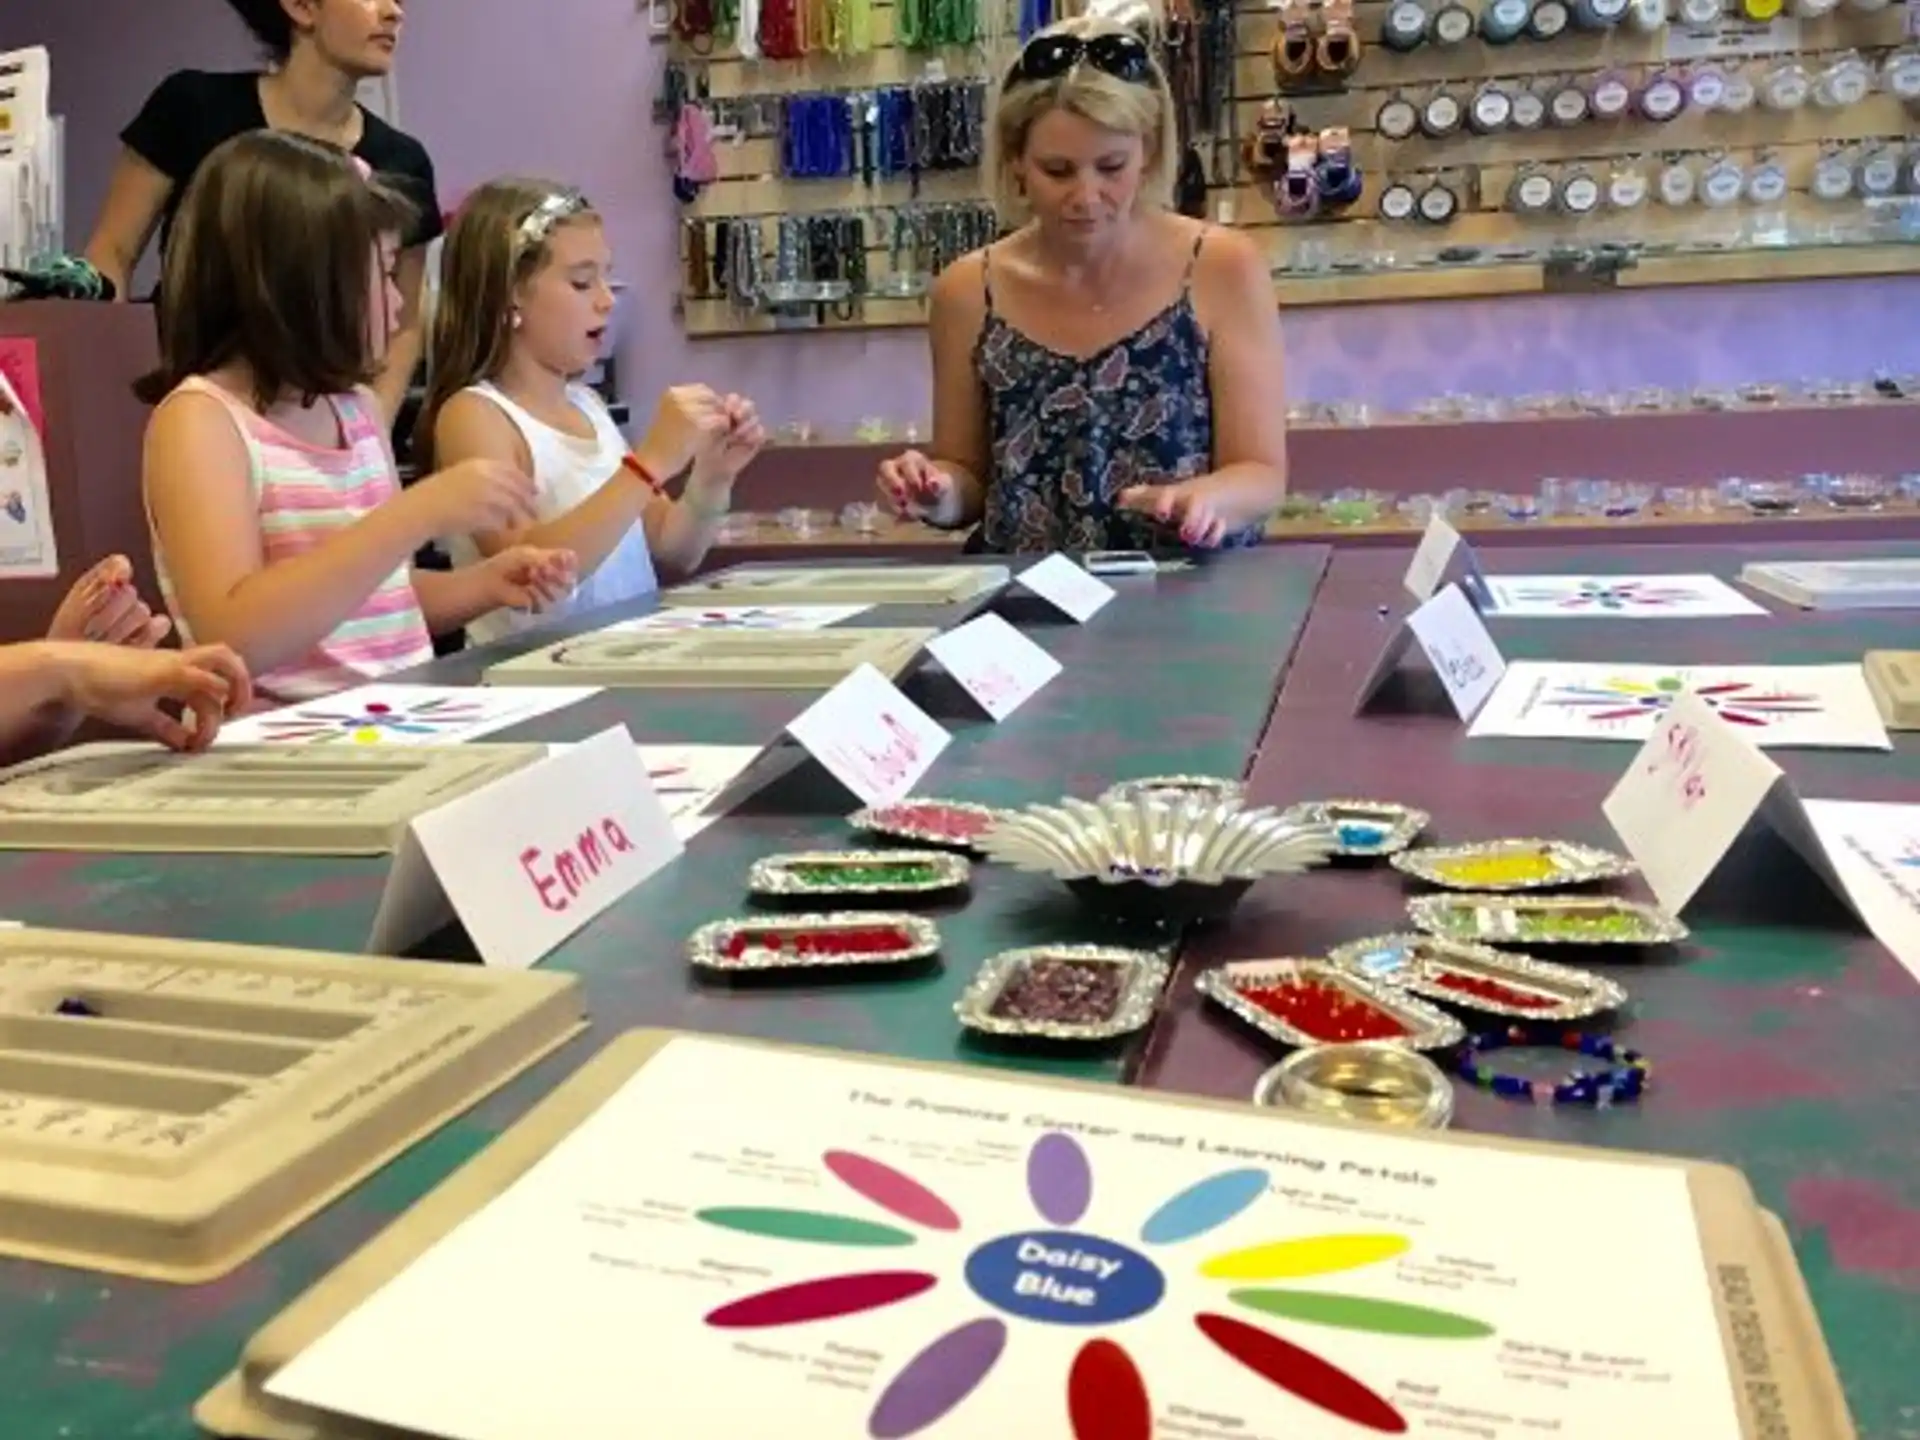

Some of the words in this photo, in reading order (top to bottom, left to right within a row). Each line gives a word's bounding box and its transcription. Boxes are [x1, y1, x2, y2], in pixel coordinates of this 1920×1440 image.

[519, 817, 637, 912] Emma
[1131, 1132, 1186, 1148] and
[1196, 1138, 1327, 1173] Learning
[1339, 1160, 1438, 1187] Petals
[1015, 1236, 1124, 1281] Daisy
[1012, 1269, 1097, 1307] Blue
